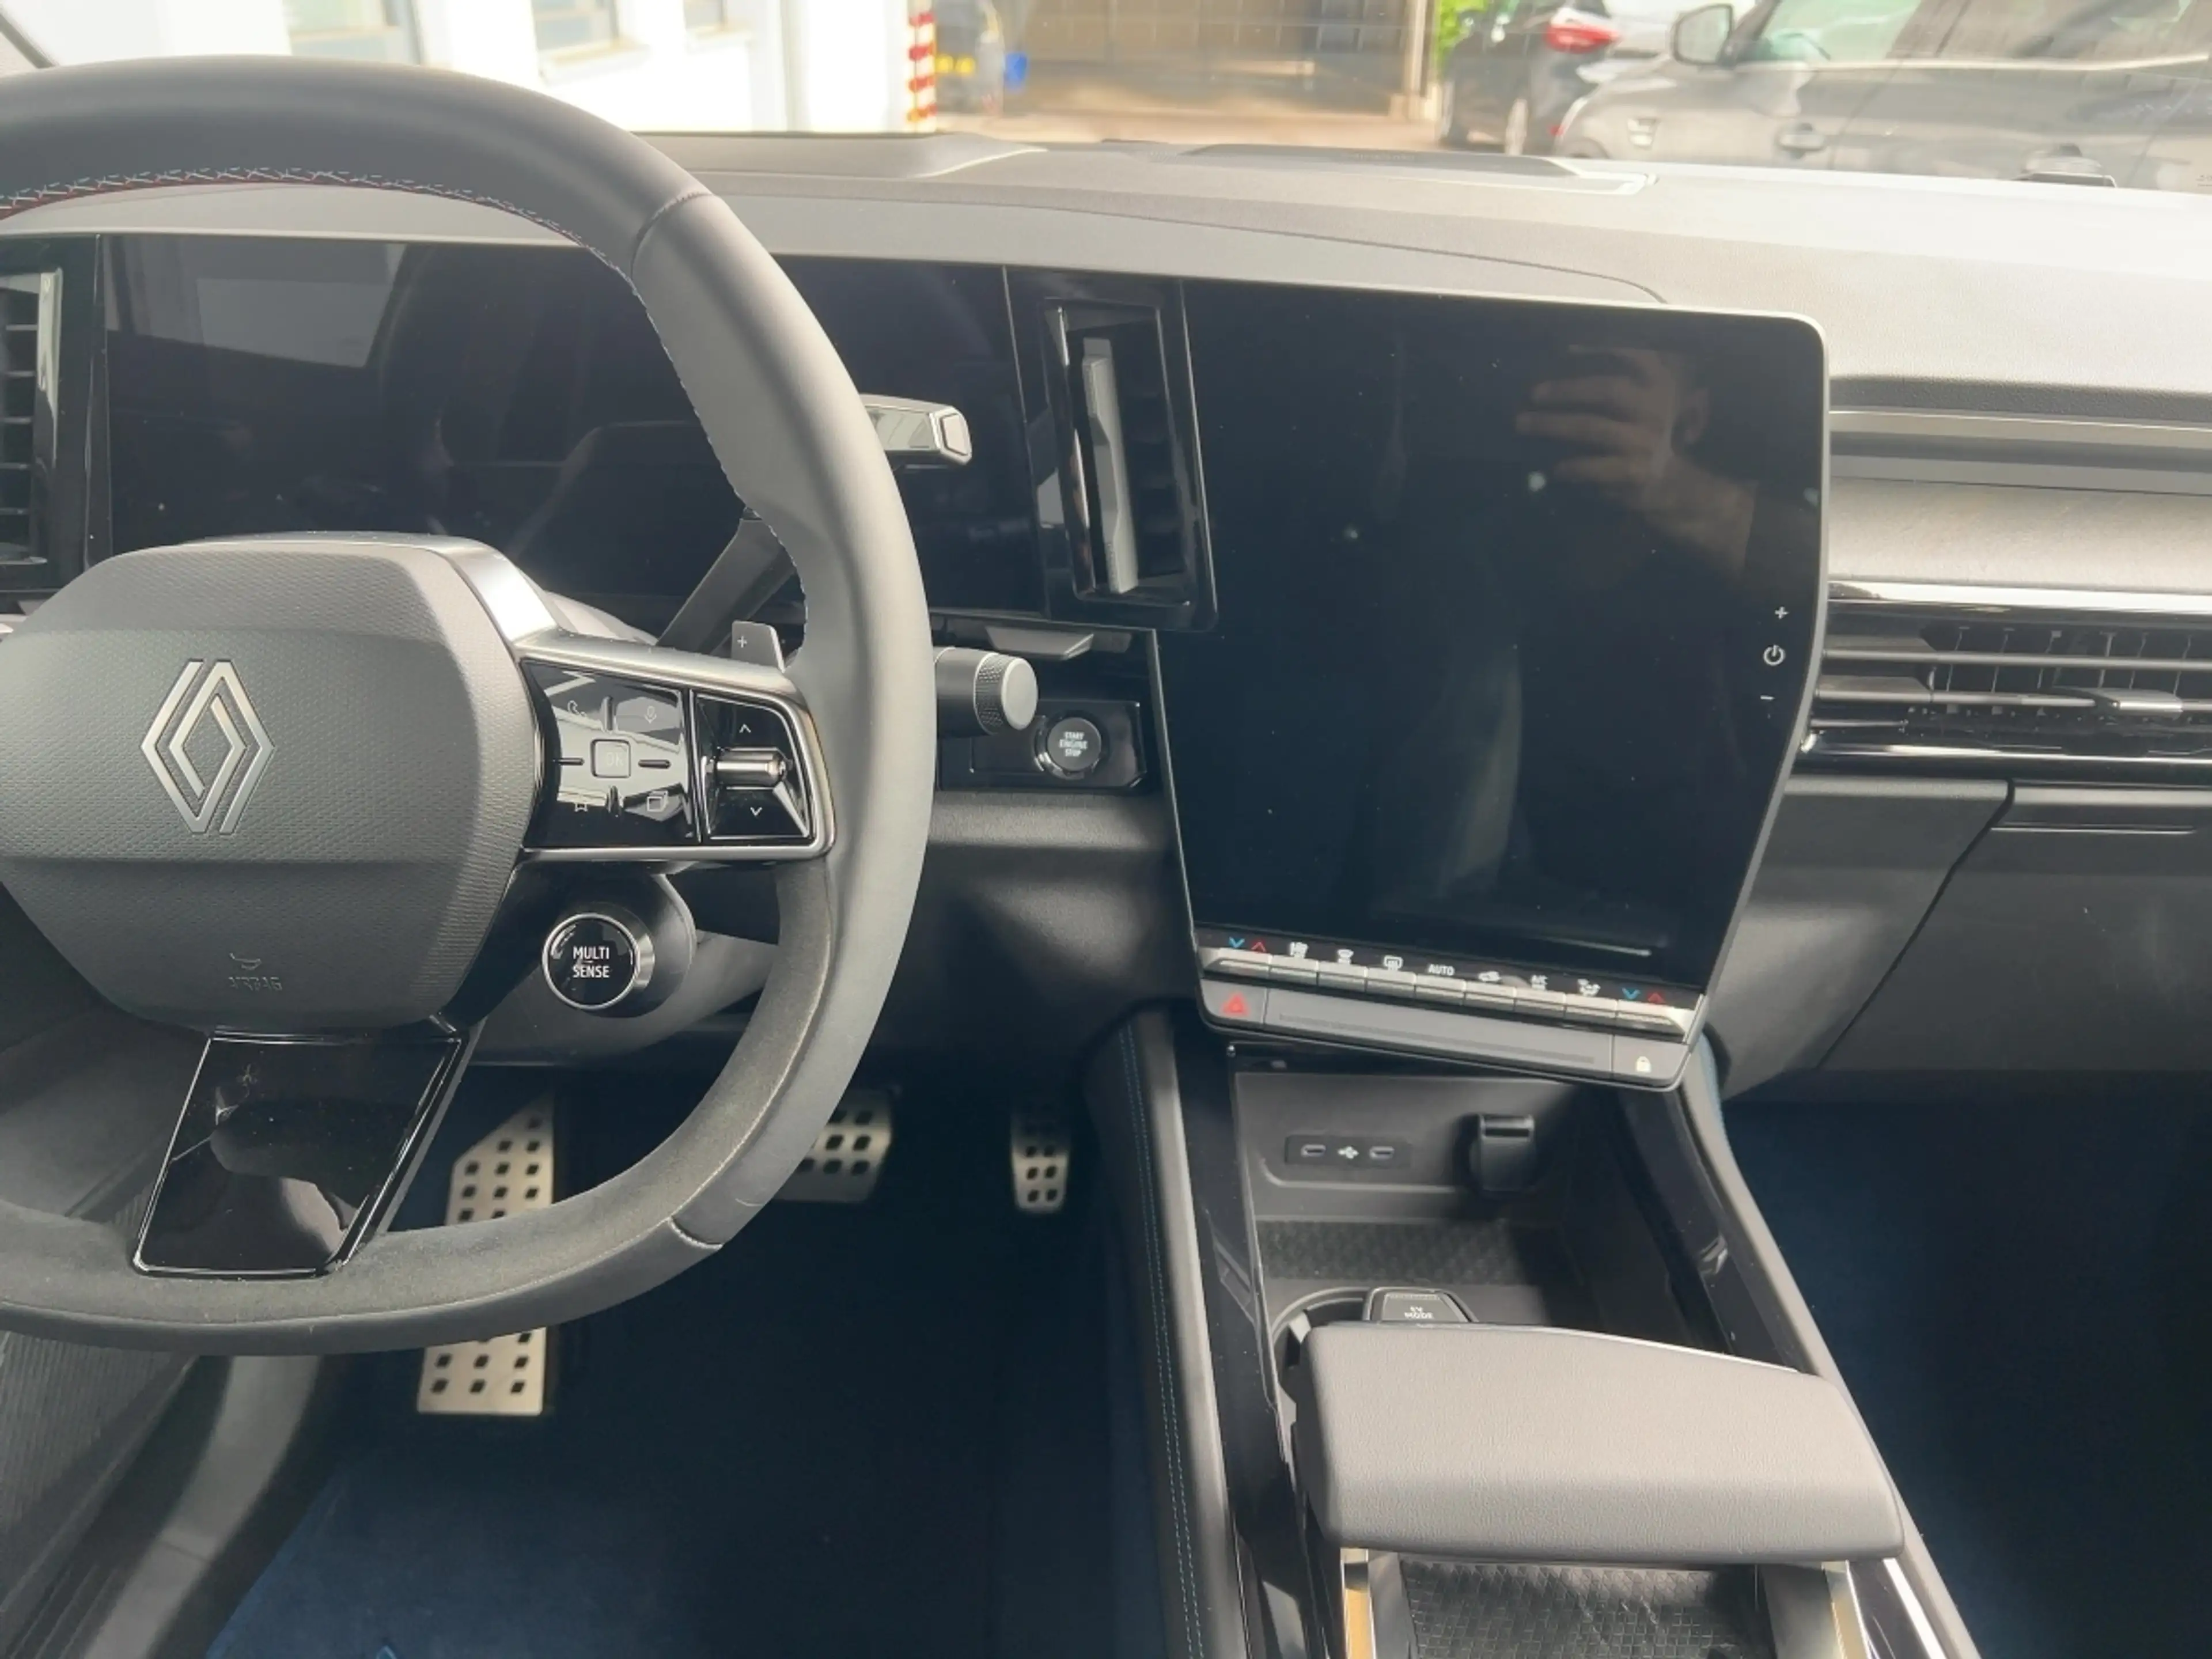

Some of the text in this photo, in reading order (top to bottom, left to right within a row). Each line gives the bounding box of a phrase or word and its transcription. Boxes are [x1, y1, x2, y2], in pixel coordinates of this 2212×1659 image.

[573, 945, 610, 960] MULTI
[573, 964, 611, 978] SENSE
[1428, 964, 1455, 976] AUTO
